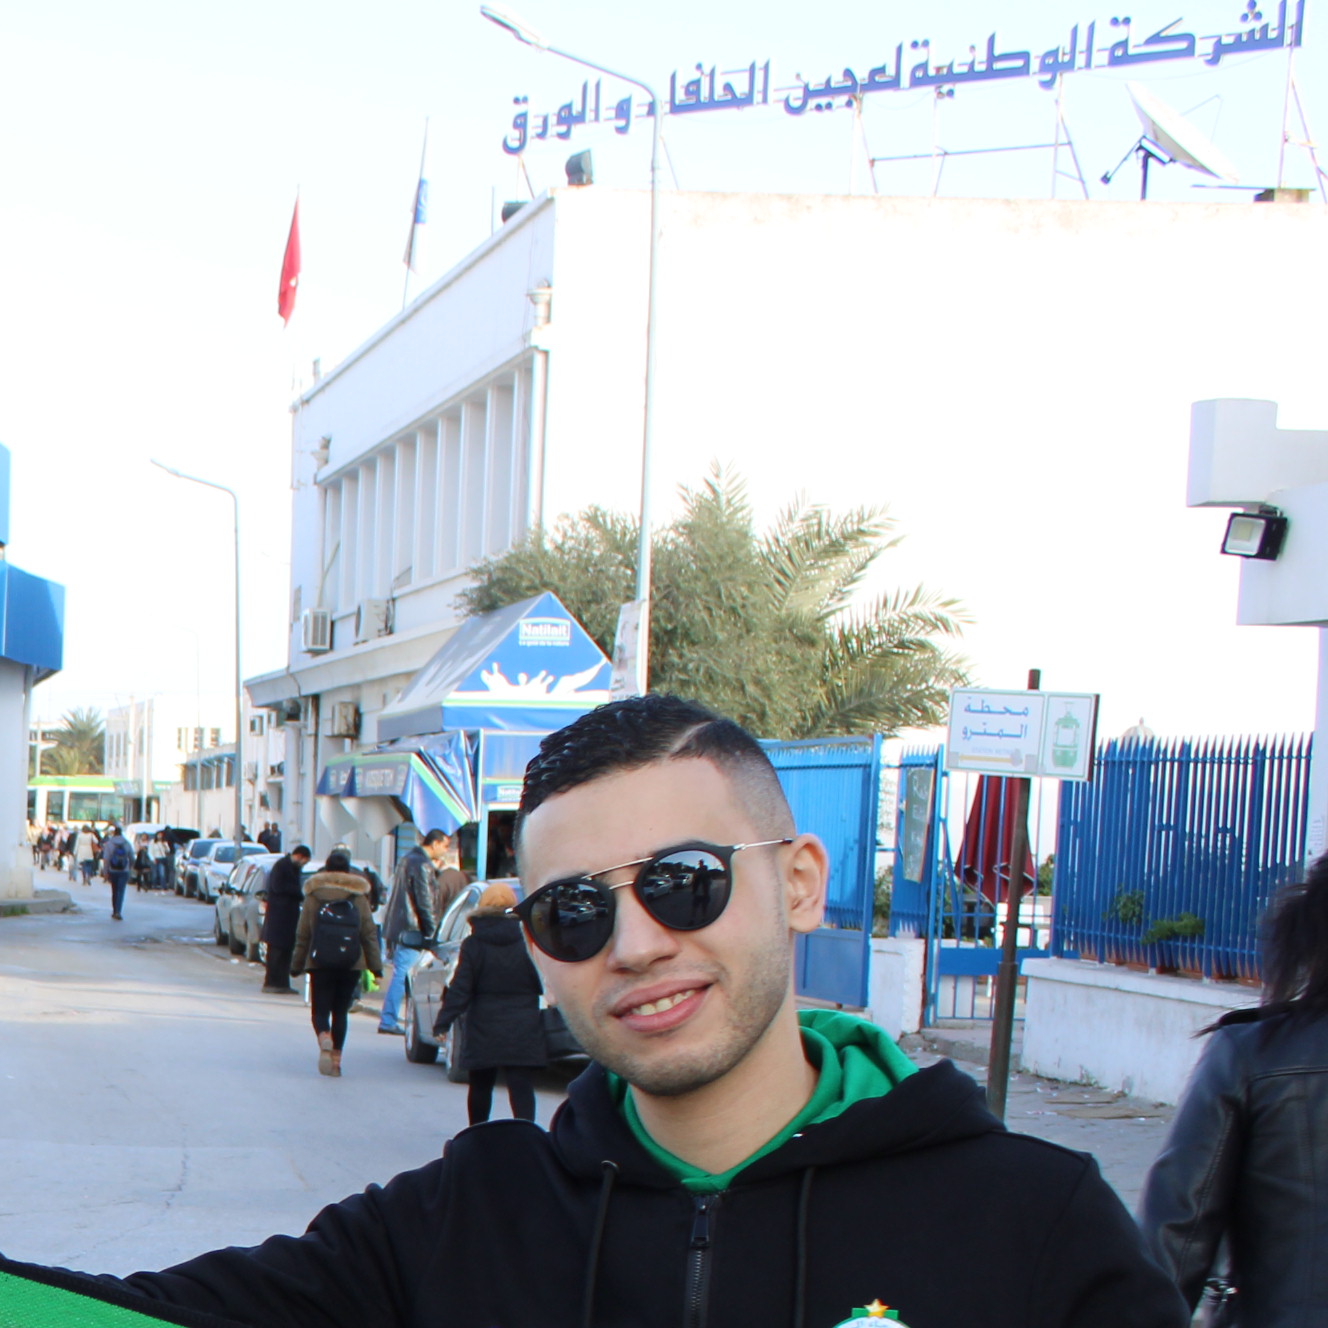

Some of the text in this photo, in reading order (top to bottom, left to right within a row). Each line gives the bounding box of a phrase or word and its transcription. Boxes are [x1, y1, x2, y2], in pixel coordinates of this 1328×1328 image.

[909, 20, 1096, 98] الوطنية
[1106, 0, 1305, 67] الشركة
[502, 78, 601, 155] الورق
[962, 722, 1028, 741] المترو
[964, 697, 1030, 717] محطة
